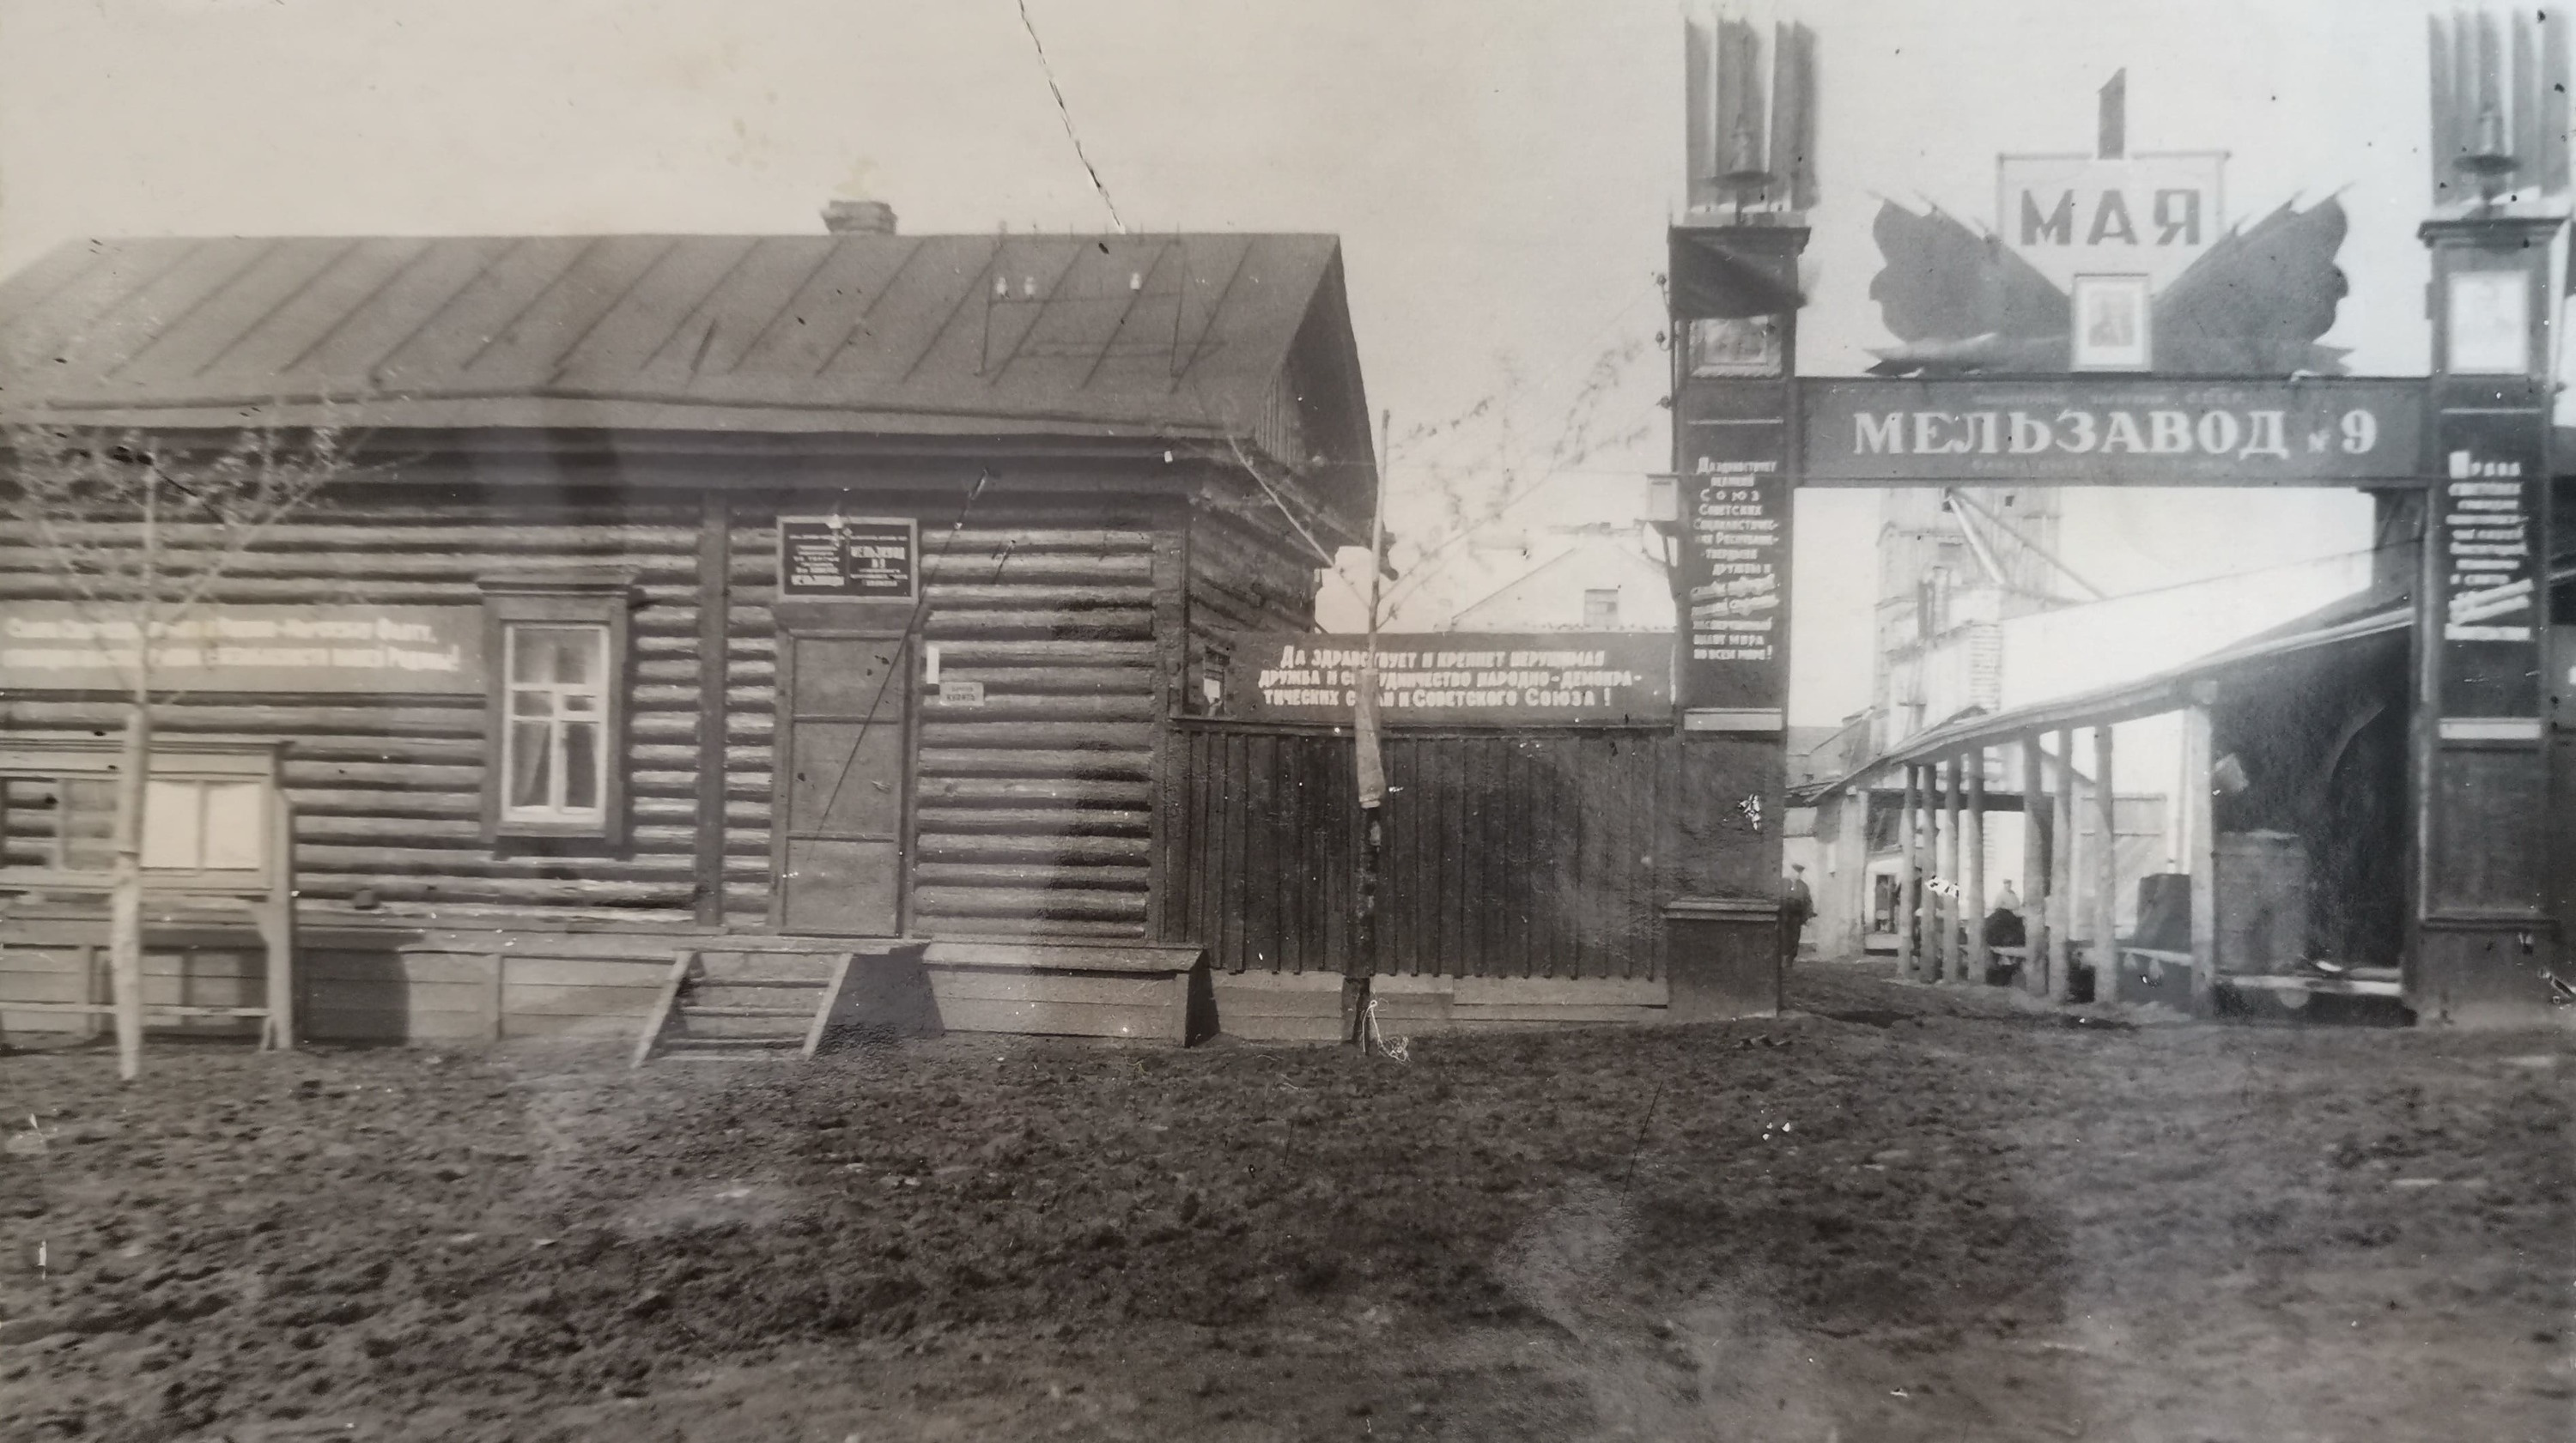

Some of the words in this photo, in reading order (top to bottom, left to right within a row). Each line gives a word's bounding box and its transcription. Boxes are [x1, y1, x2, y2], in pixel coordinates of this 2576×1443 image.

[2096, 64, 2128, 161] 1
[2020, 187, 2202, 246] МАЯ
[1853, 409, 2290, 462] МЕЛЬЗАВОД
[2339, 408, 2379, 455] 9
[1327, 670, 1338, 686] И
